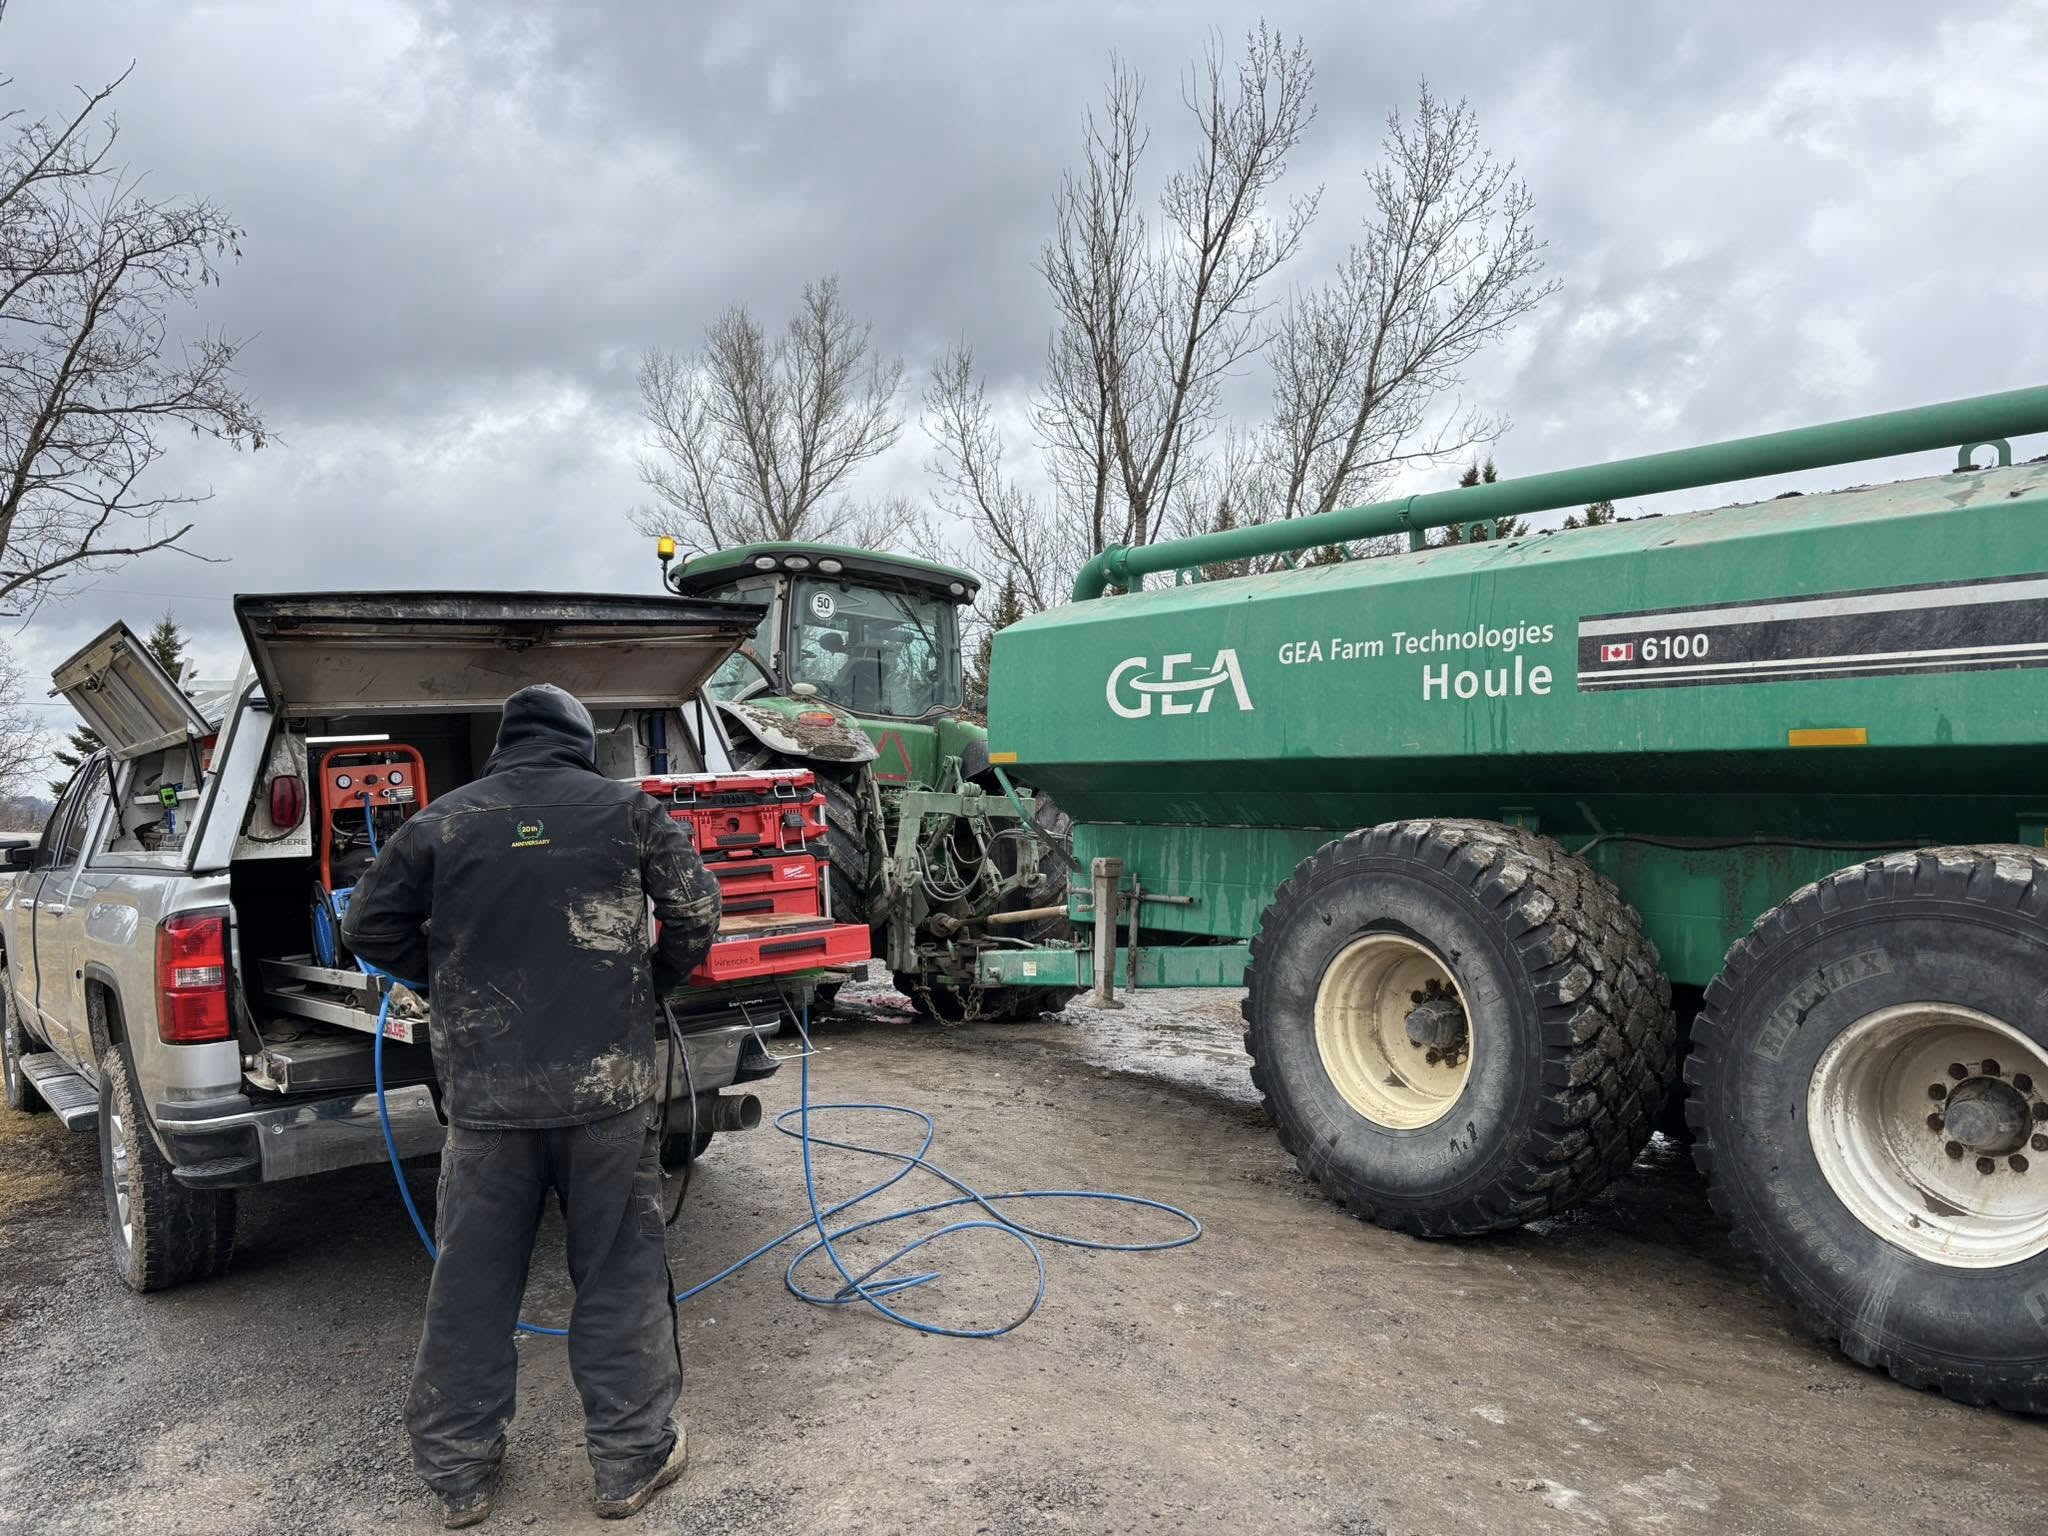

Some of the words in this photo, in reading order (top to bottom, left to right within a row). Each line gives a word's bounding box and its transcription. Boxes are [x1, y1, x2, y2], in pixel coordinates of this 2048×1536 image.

[816, 596, 830, 609] 50
[1278, 642, 1324, 665] GEA
[1330, 637, 1384, 661] Farm
[1391, 623, 1555, 653] Technologies
[1641, 633, 1709, 661] 6100
[1106, 648, 1255, 719] GEA
[1423, 655, 1553, 701] Houle
[271, 838, 308, 846] DEERE
[511, 839, 551, 848] ANNIVERSARY
